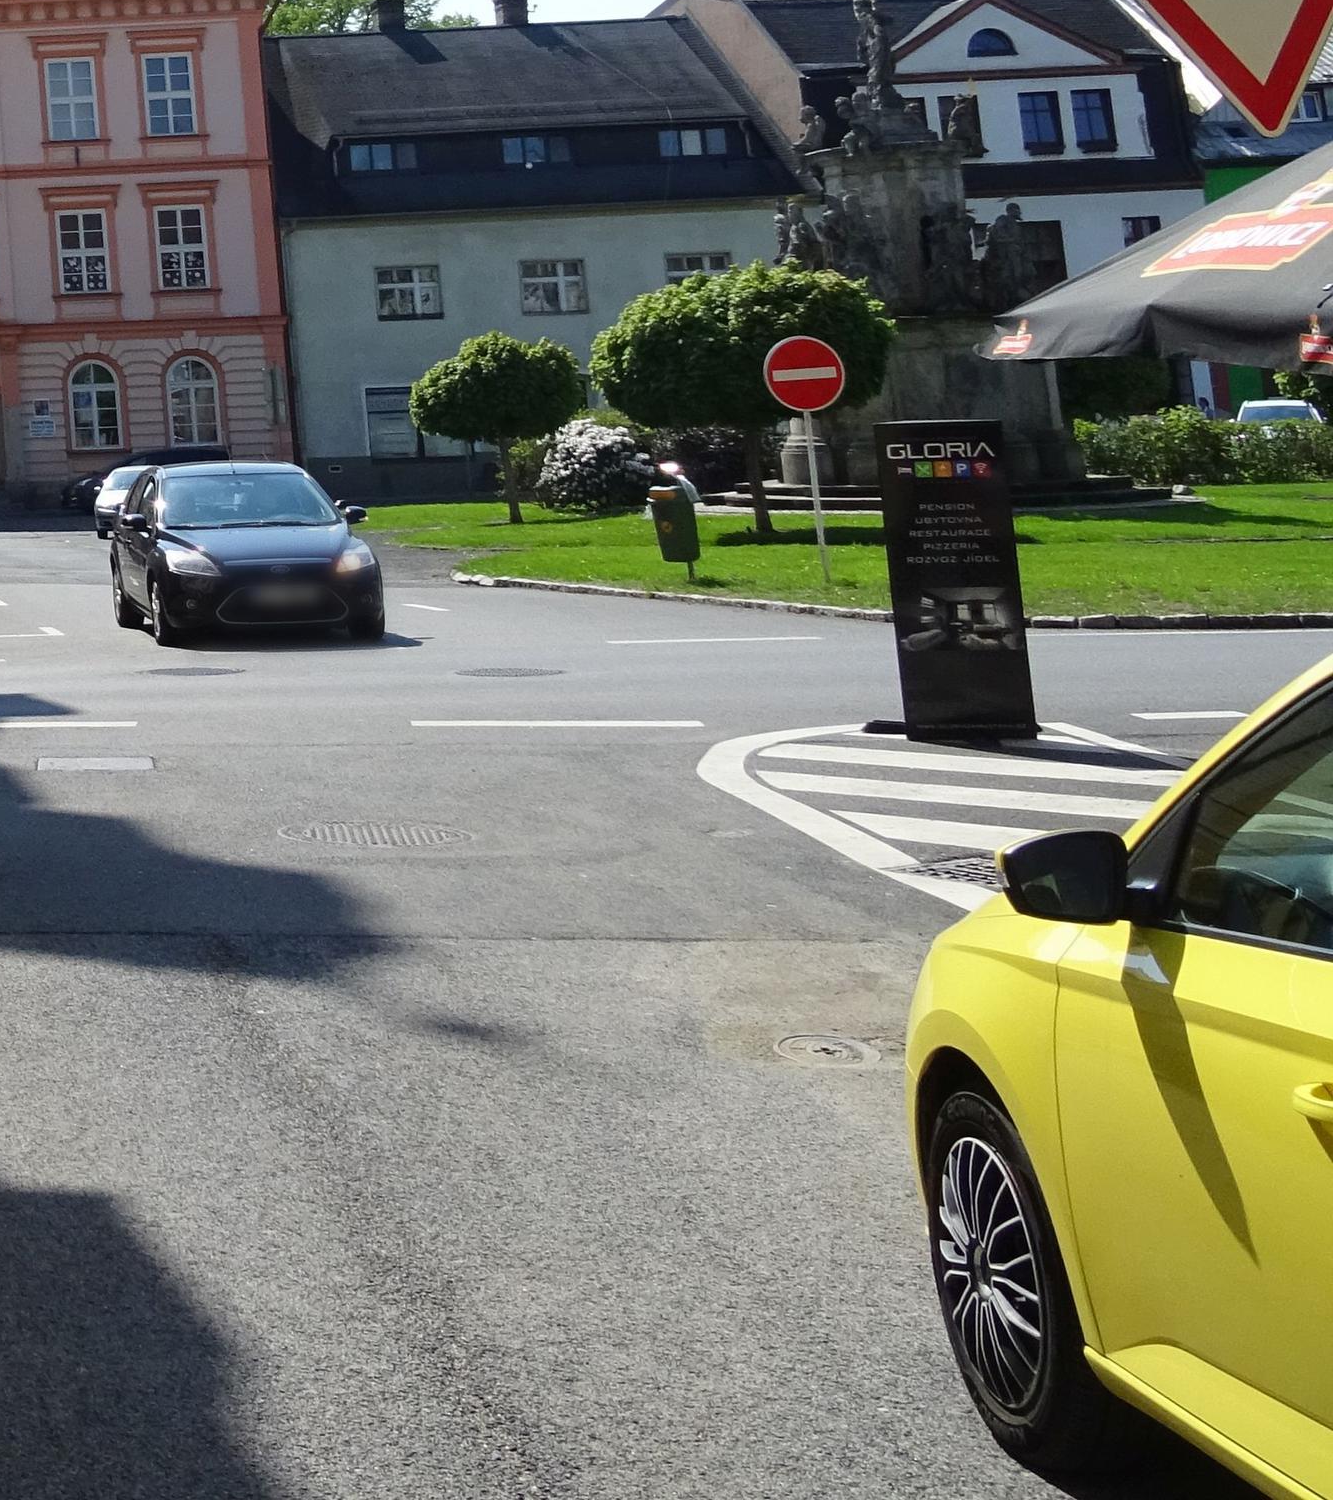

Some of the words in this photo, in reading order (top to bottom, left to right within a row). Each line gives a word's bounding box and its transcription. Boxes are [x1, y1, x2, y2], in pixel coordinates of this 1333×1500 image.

[886, 442, 995, 460] GLORIA
[919, 503, 976, 512] PENSION
[915, 516, 983, 525] UBYTOVNA
[909, 529, 992, 538] RESTAURACE
[923, 542, 980, 551] PIZZERIA
[906, 556, 958, 564] ROZVOZ
[963, 553, 1000, 563] JÍDEL
